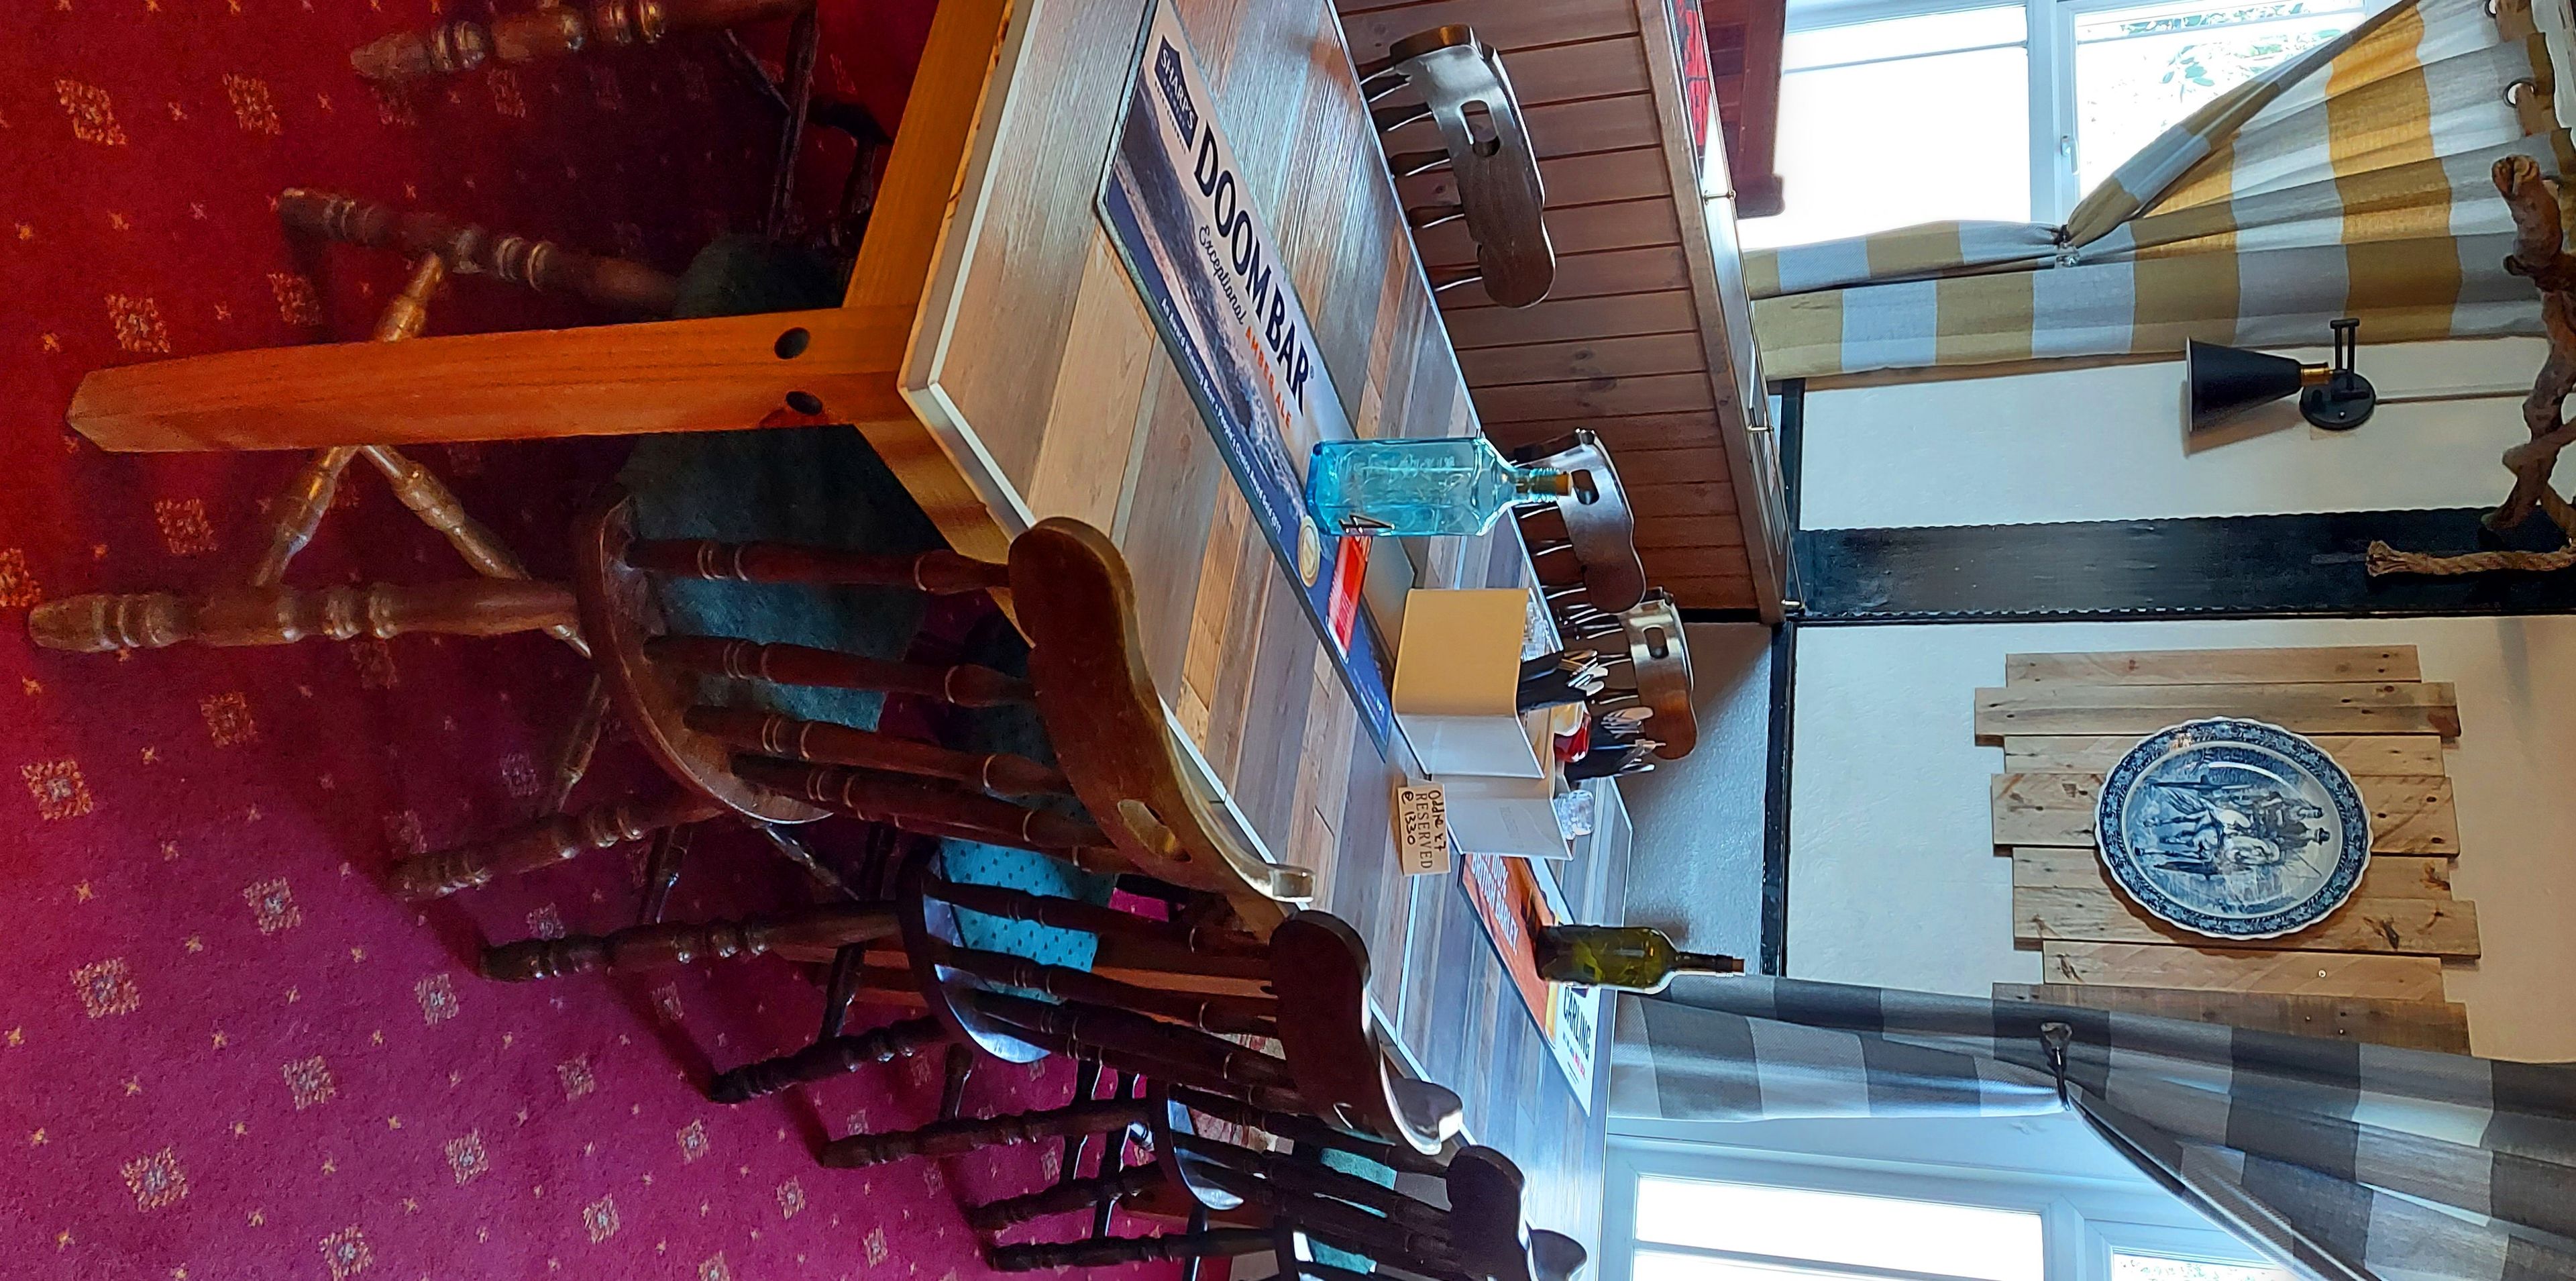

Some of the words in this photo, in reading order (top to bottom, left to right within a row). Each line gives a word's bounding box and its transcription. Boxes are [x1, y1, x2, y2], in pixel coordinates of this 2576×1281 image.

[1161, 48, 1195, 130] SHARP'S
[1161, 297, 1170, 317] An
[1169, 312, 1186, 348] Award
[1185, 340, 1205, 387] Winning
[1203, 378, 1216, 405] Beer
[1199, 225, 1248, 325] Exceptional
[1245, 325, 1275, 393] AMBER
[1275, 391, 1292, 430] ALE
[1338, 513, 1395, 534] 4
[1404, 811, 1417, 845] 1330
[1415, 793, 1433, 868] RESERVED
[1471, 853, 1497, 911] BRITISH
[1563, 986, 1591, 1062] CARLING
